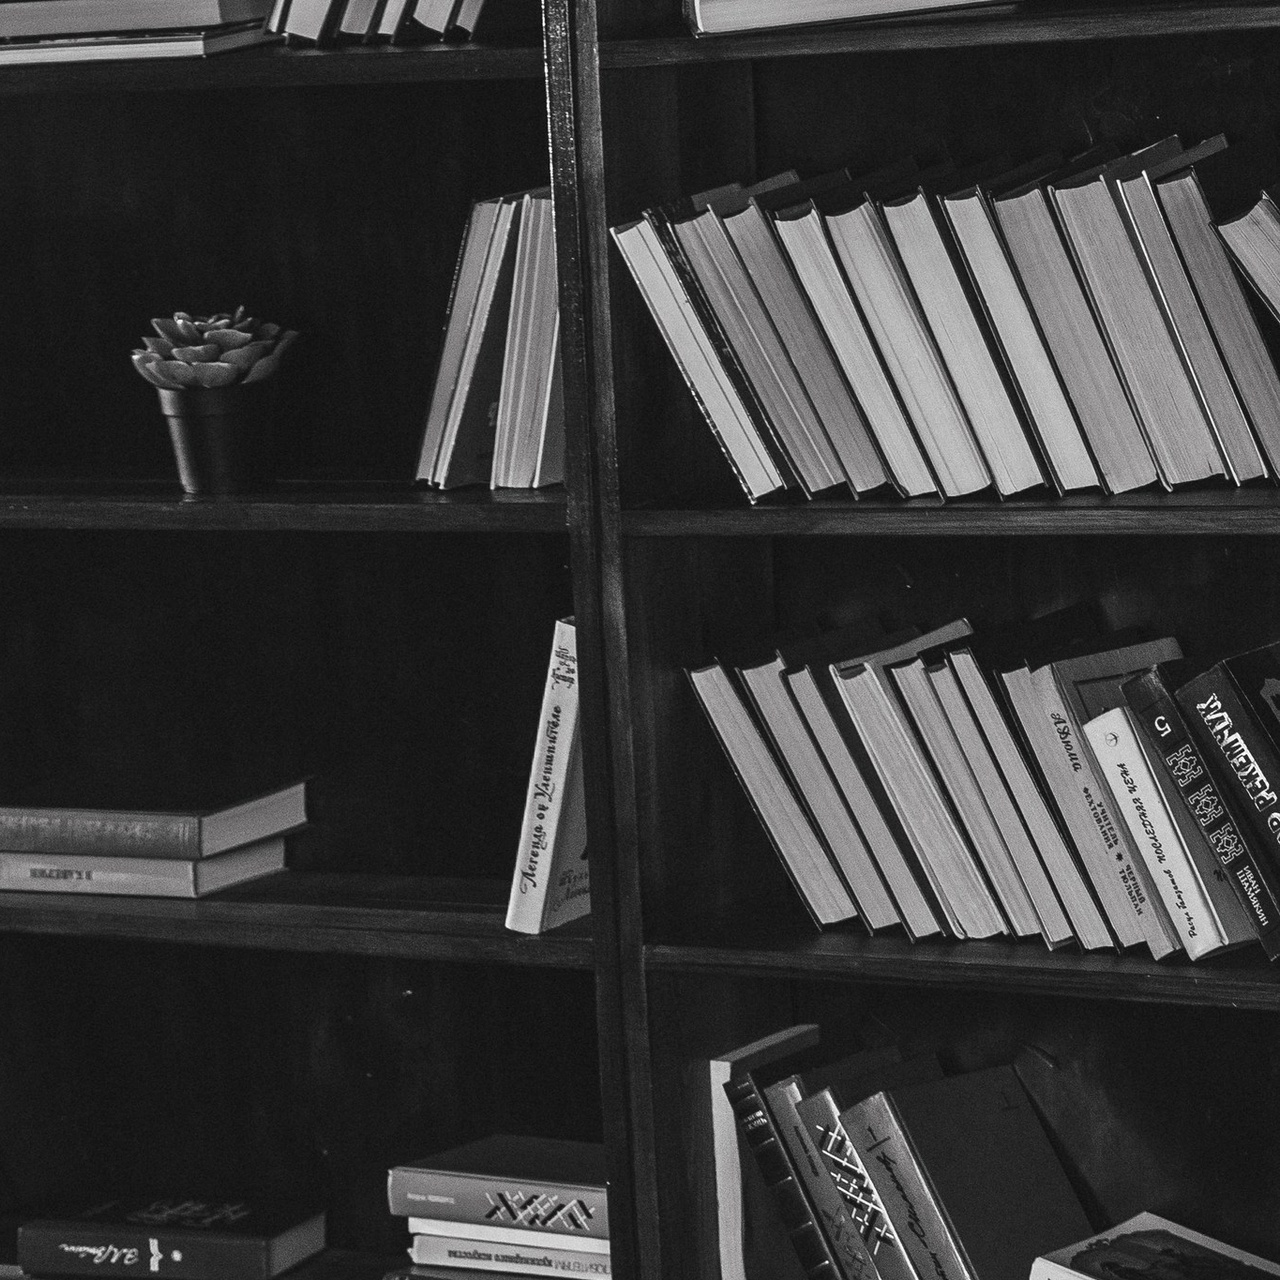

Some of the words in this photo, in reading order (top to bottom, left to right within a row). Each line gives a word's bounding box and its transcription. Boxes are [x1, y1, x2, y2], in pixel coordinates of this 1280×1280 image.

[1154, 715, 1172, 737] 5
[1196, 693, 1278, 812] РЕКЕМЧУК
[1116, 762, 1138, 795] ЦЕНА
[1083, 786, 1114, 850] ФЕХТОВАНИЯ
[1096, 802, 1120, 847] УЧИТЕЛЬ
[1132, 796, 1167, 865] ПОСЛЕДНЯЯ
[1119, 868, 1144, 916] ТЮЛЬПАН
[1236, 869, 1270, 927] ШАМЯКИН
[1243, 864, 1261, 898] ИВАН
